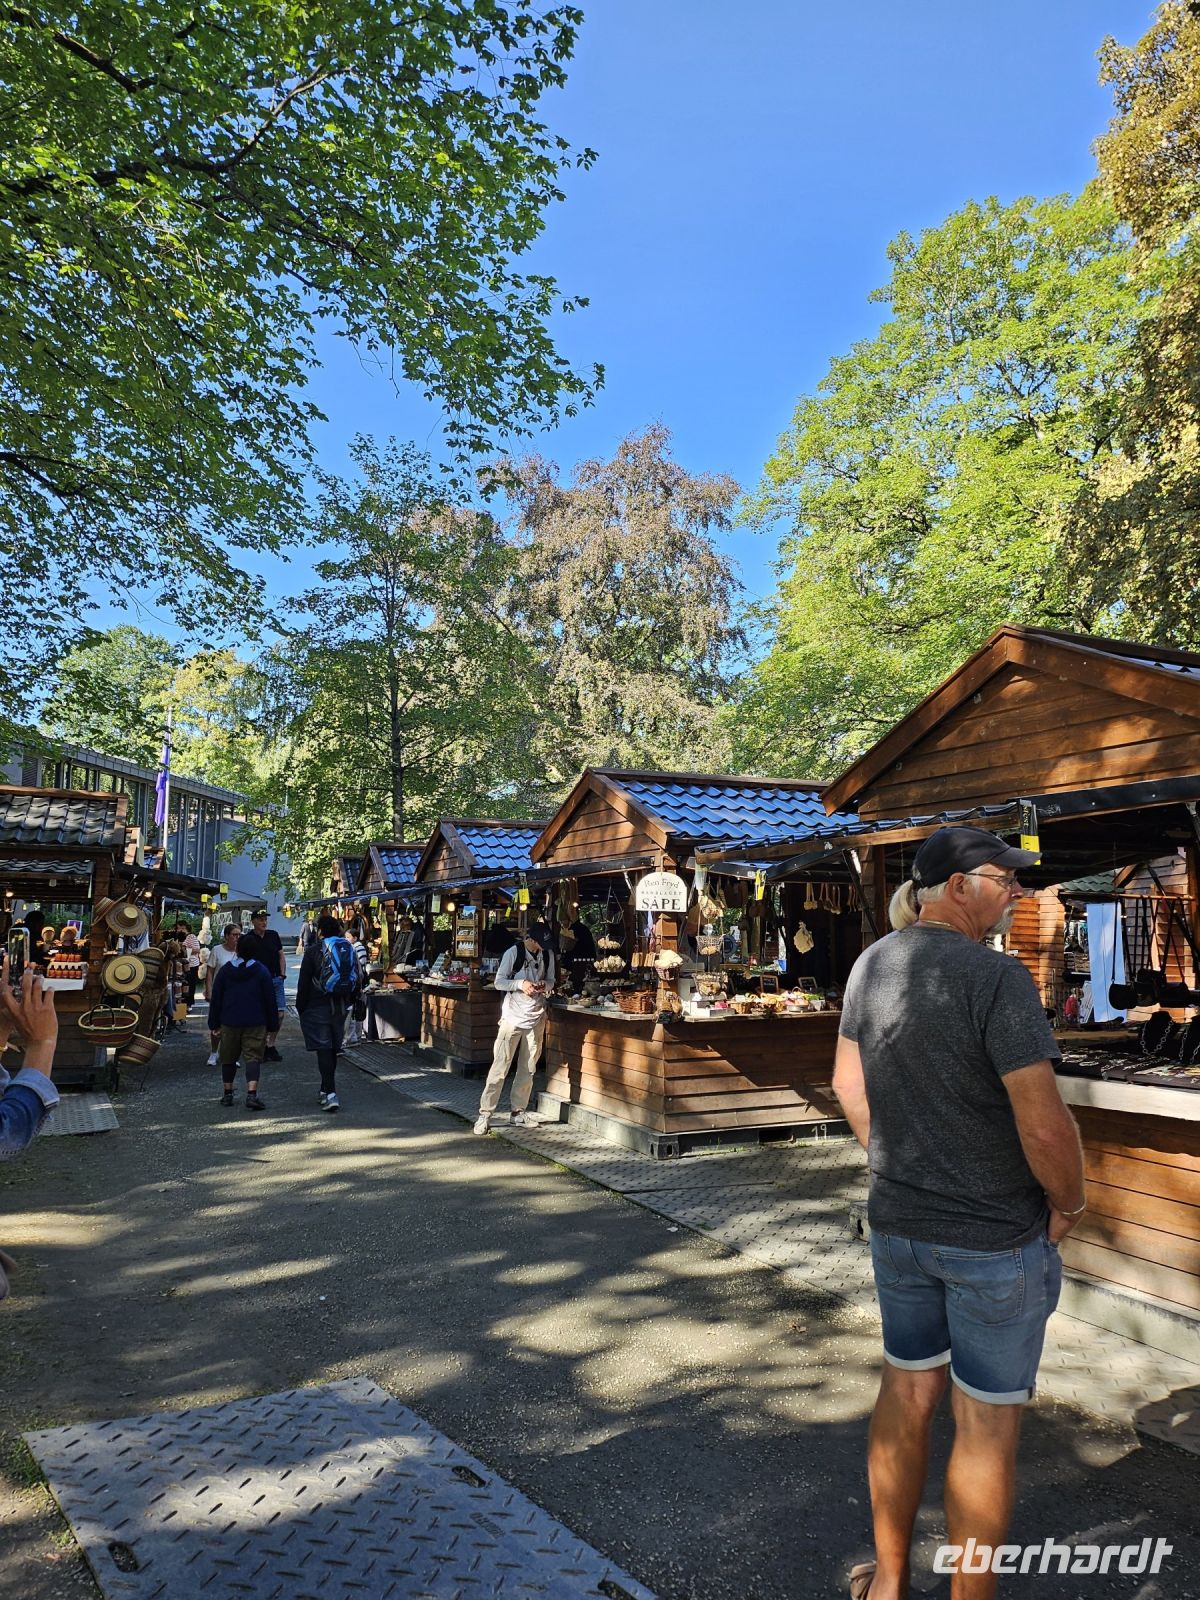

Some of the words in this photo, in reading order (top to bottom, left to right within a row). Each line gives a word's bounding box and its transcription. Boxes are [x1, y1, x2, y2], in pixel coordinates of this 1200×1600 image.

[645, 879, 660, 887] Ren
[661, 878, 680, 889] Fryd
[641, 896, 681, 910] SÅPE
[811, 1123, 827, 1140] 19
